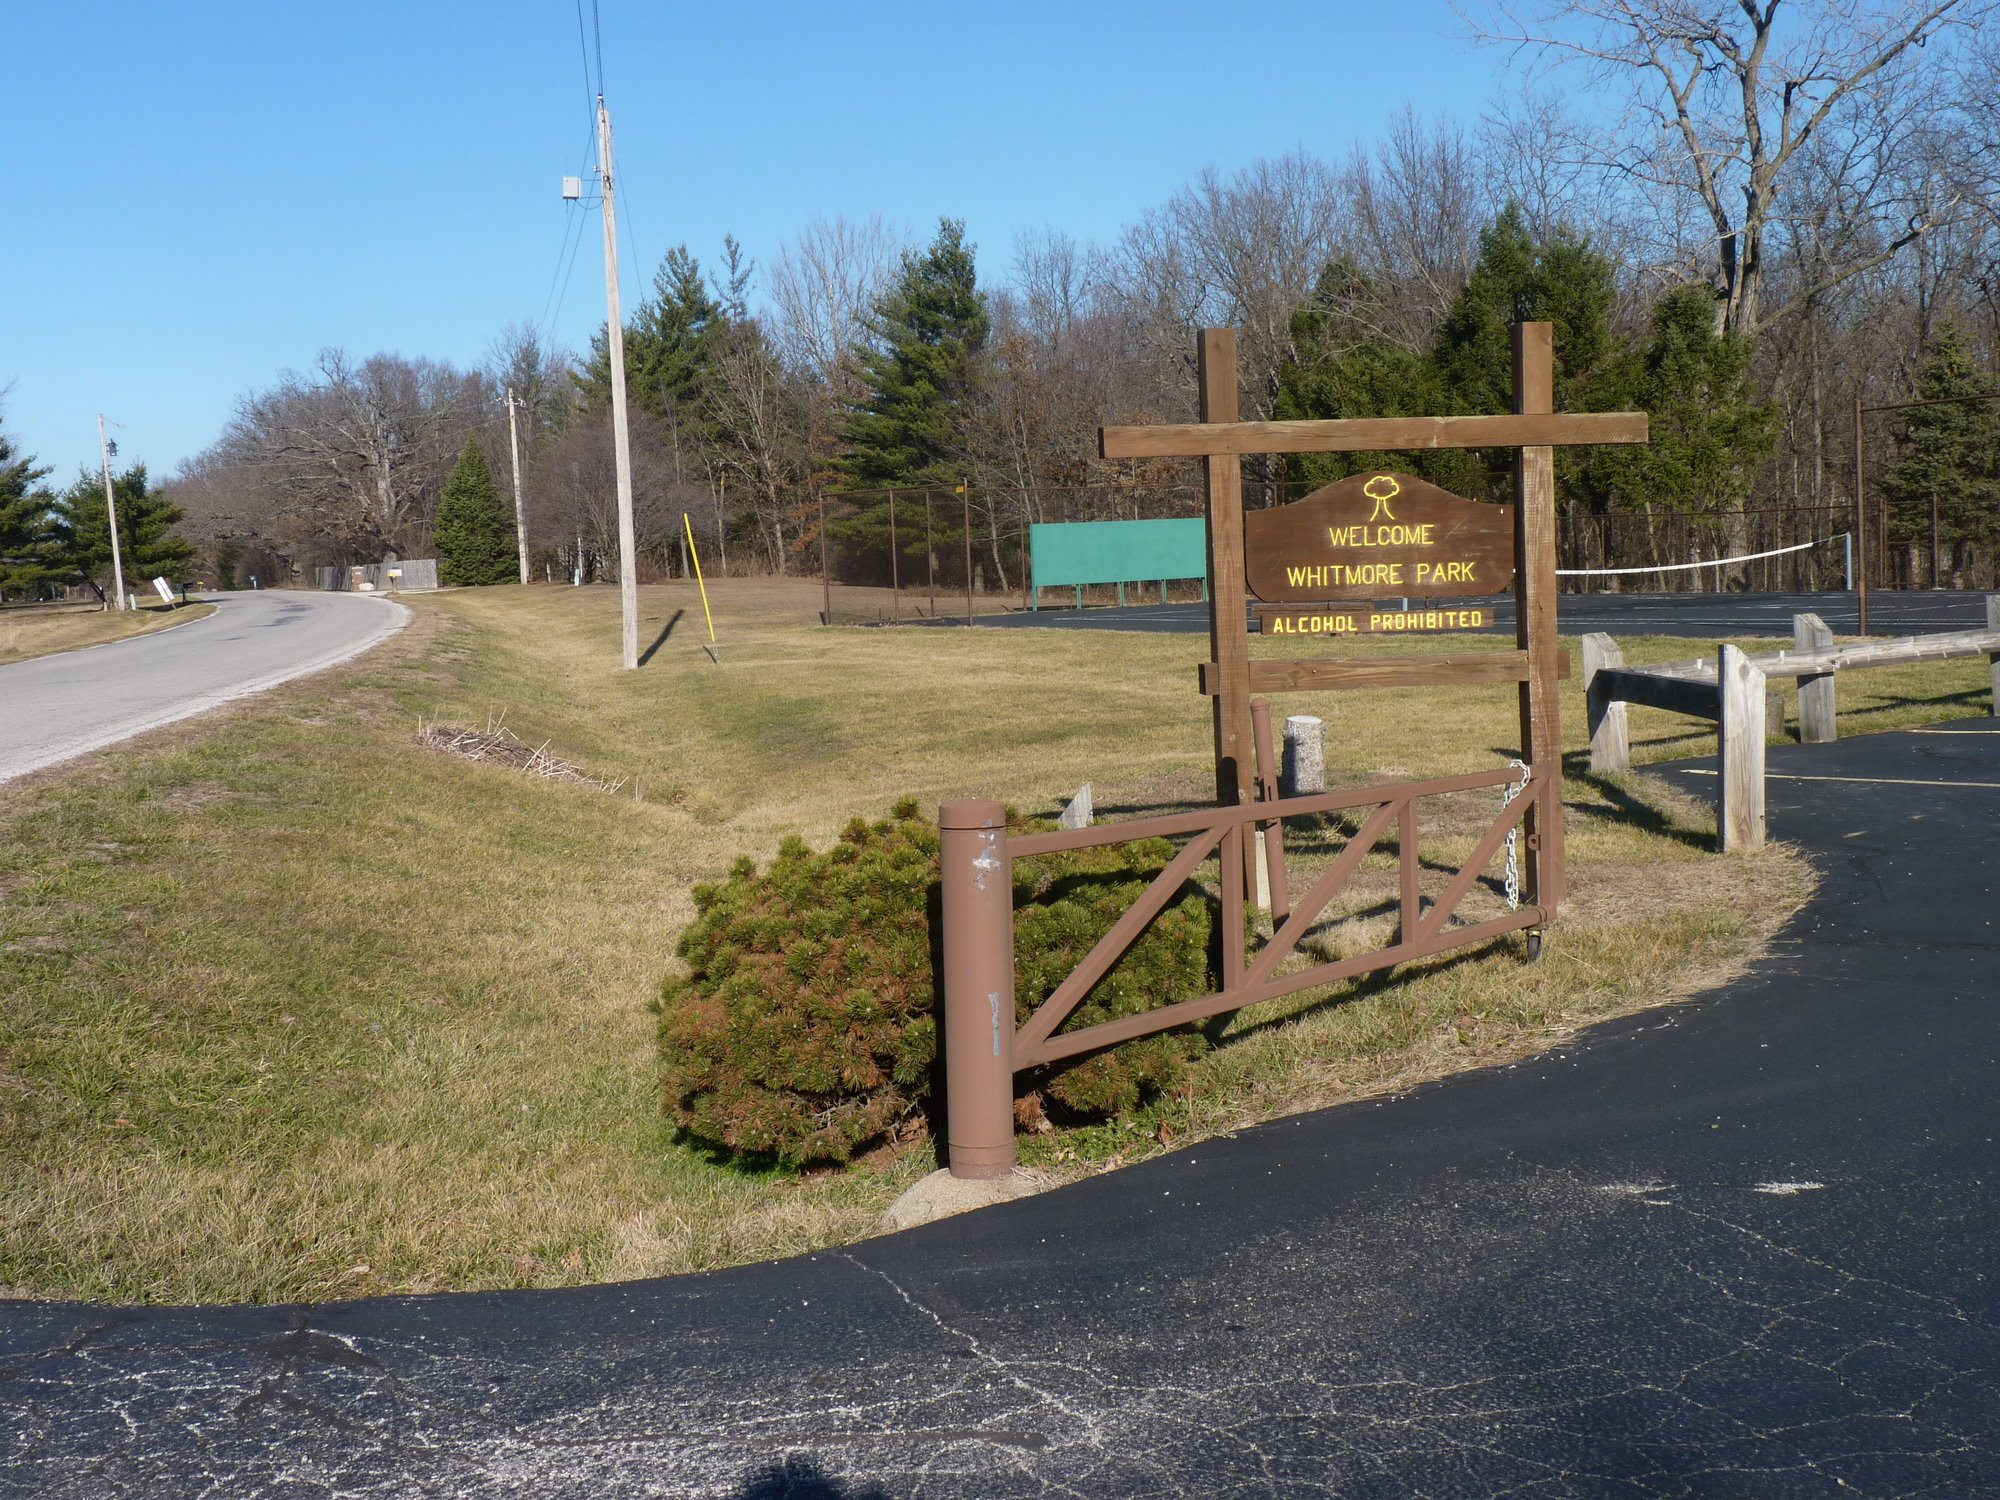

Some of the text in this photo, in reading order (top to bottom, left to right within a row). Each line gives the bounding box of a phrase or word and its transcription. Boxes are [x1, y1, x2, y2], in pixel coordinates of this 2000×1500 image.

[1329, 524, 1434, 547] WELCOME
[1287, 562, 1475, 588] WHITMORE PARK
[1273, 610, 1482, 634] ALCOHOL PROHIBITED
